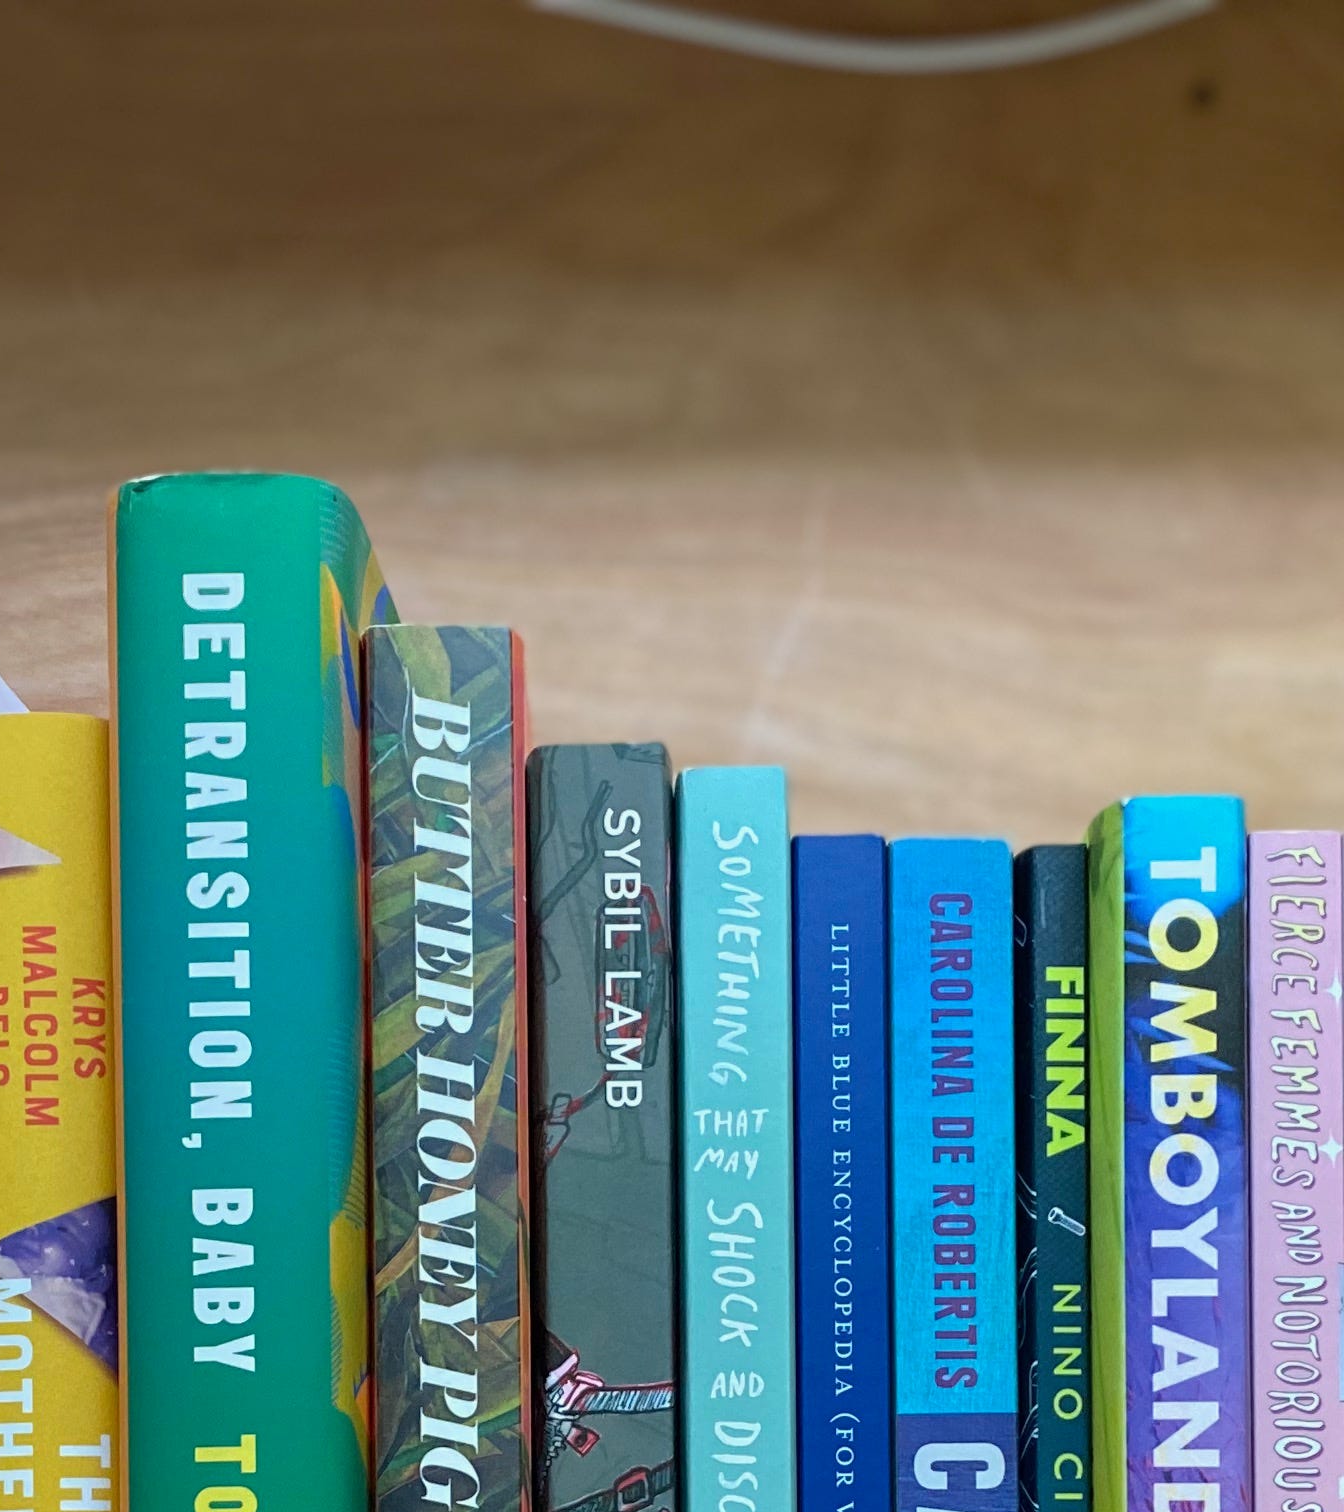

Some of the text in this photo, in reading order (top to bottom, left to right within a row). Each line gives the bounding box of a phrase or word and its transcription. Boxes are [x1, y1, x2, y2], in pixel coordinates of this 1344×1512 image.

[182, 572, 253, 1148] DETRANSITION,
[411, 687, 475, 1035] BUTTER
[1266, 846, 1327, 995] FIERCE
[23, 926, 59, 1127] MALCOLM
[72, 977, 106, 1080] KRYS
[603, 808, 643, 1108] SYBIL LAMB
[708, 822, 764, 1086] SOMETHING
[831, 923, 851, 1039] LITTLE
[693, 1108, 769, 1135] THAT
[832, 1055, 851, 1133] BLUE
[1045, 966, 1085, 1157] FINNA
[1270, 1009, 1322, 1190] FEMMES
[415, 1046, 478, 1351] HONEY
[693, 1150, 758, 1179] MAY
[929, 893, 977, 1390] CAROLINA DE ROBERTIS
[192, 1187, 256, 1373] BABY
[707, 1198, 764, 1348] SHOCK
[832, 1150, 853, 1397] ENCYCLOPEDIA
[1271, 1201, 1324, 1264] AND
[711, 1370, 765, 1399] AND
[1052, 1283, 1084, 1421] NINO
[419, 1355, 481, 1511] PIG
[829, 1412, 860, 1488] (FOR
